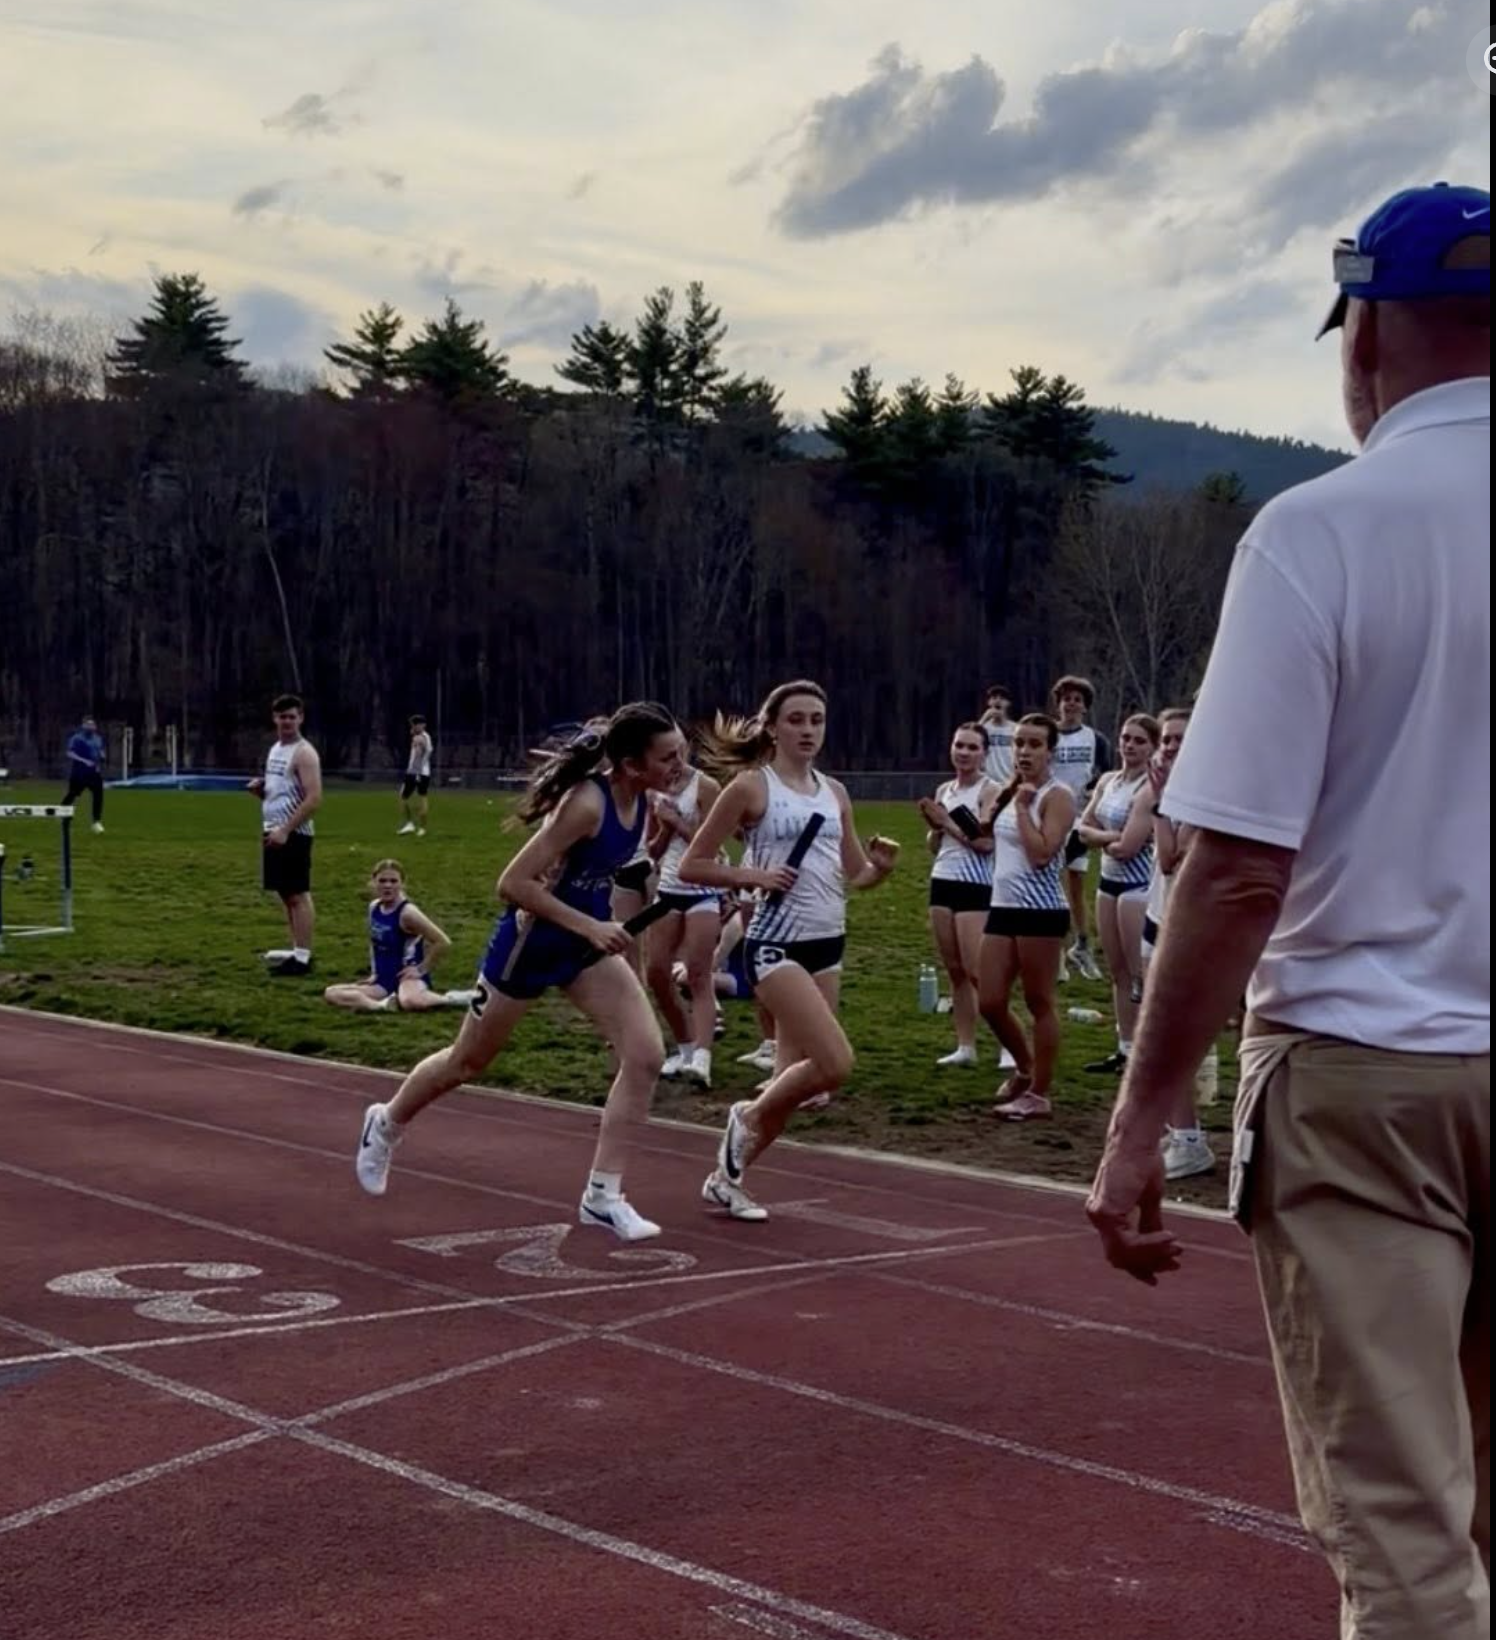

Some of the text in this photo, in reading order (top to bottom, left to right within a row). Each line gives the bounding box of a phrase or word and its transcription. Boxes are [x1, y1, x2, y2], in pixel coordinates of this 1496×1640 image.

[471, 984, 488, 1017] 2
[391, 1223, 698, 1279] 2
[44, 1262, 341, 1324] 3
